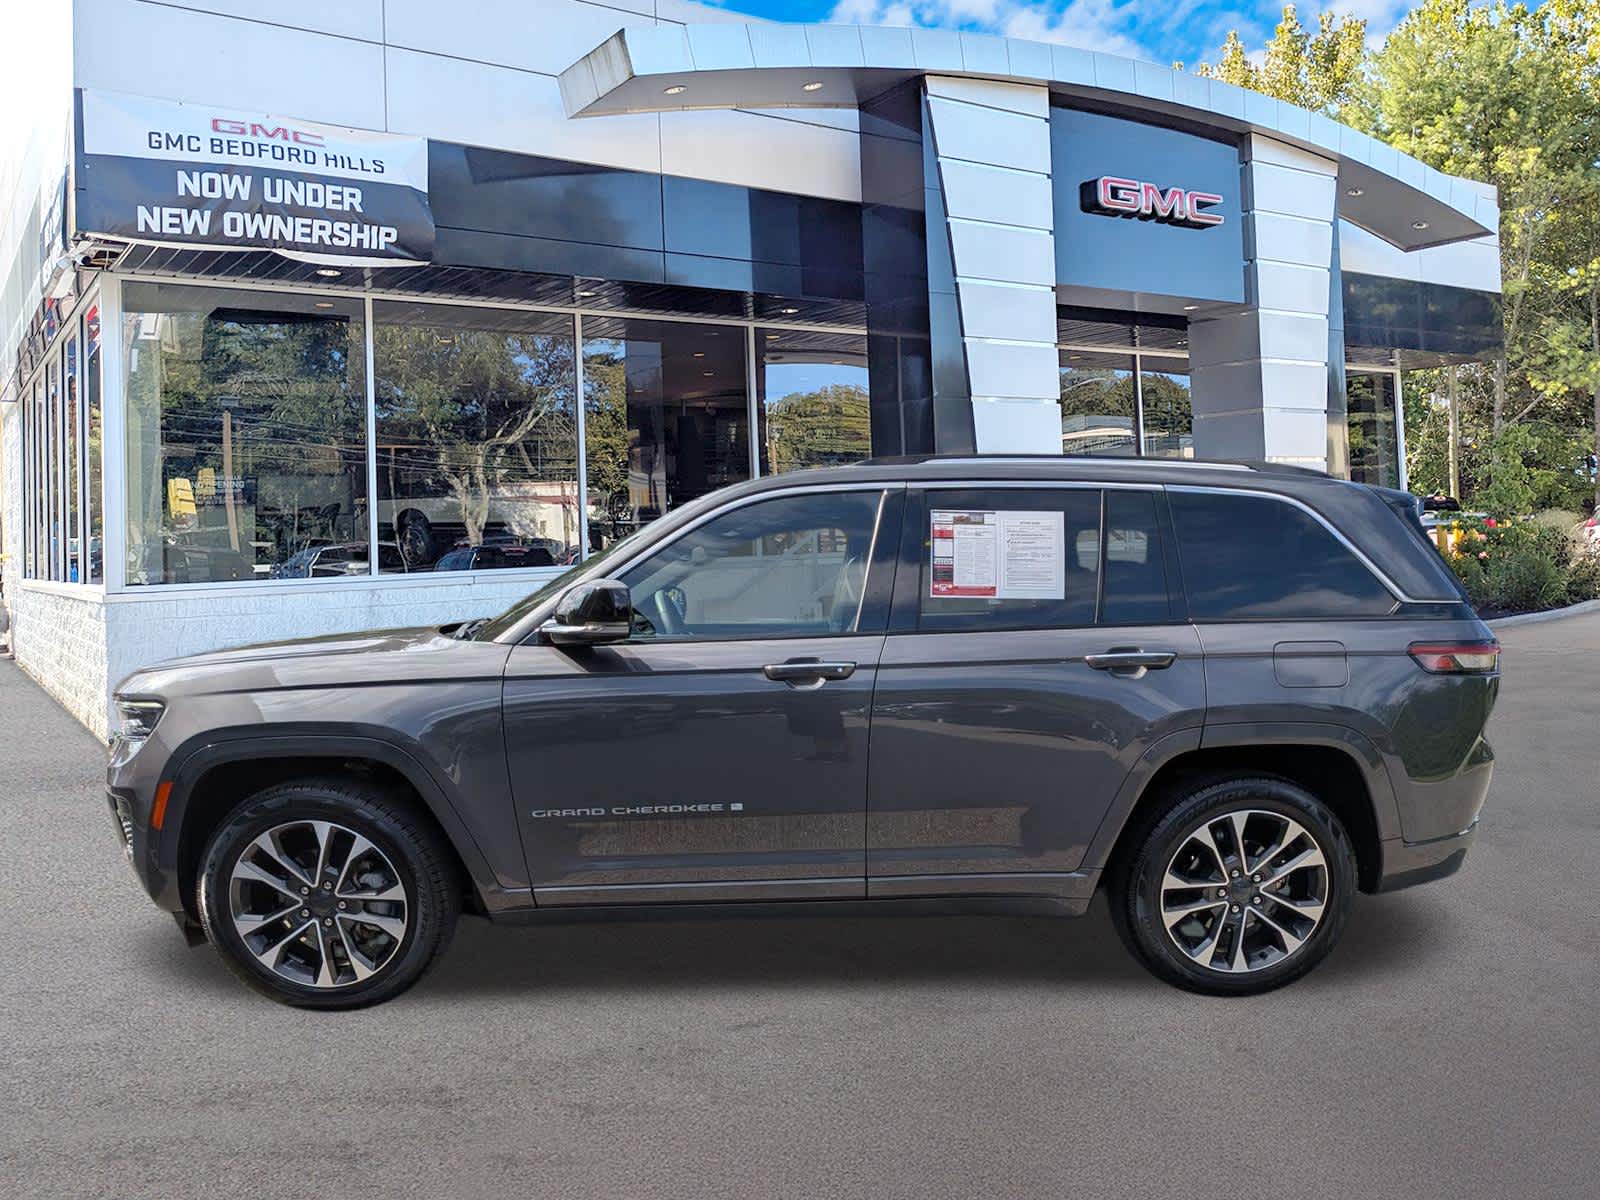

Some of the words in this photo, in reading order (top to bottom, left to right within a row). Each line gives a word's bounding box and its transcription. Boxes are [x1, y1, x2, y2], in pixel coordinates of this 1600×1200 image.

[147, 131, 201, 153] GMC
[209, 137, 317, 165] BEDFORD
[323, 152, 385, 174] HILLS
[210, 118, 326, 148] GMC
[176, 170, 253, 201] NOW
[263, 177, 364, 213] UNDER
[1097, 175, 1225, 225] GMC
[136, 205, 212, 236] NEW
[223, 211, 398, 250] OWNERSHIP
[531, 808, 605, 818] GRAND
[611, 803, 724, 815] CHEROKEE
